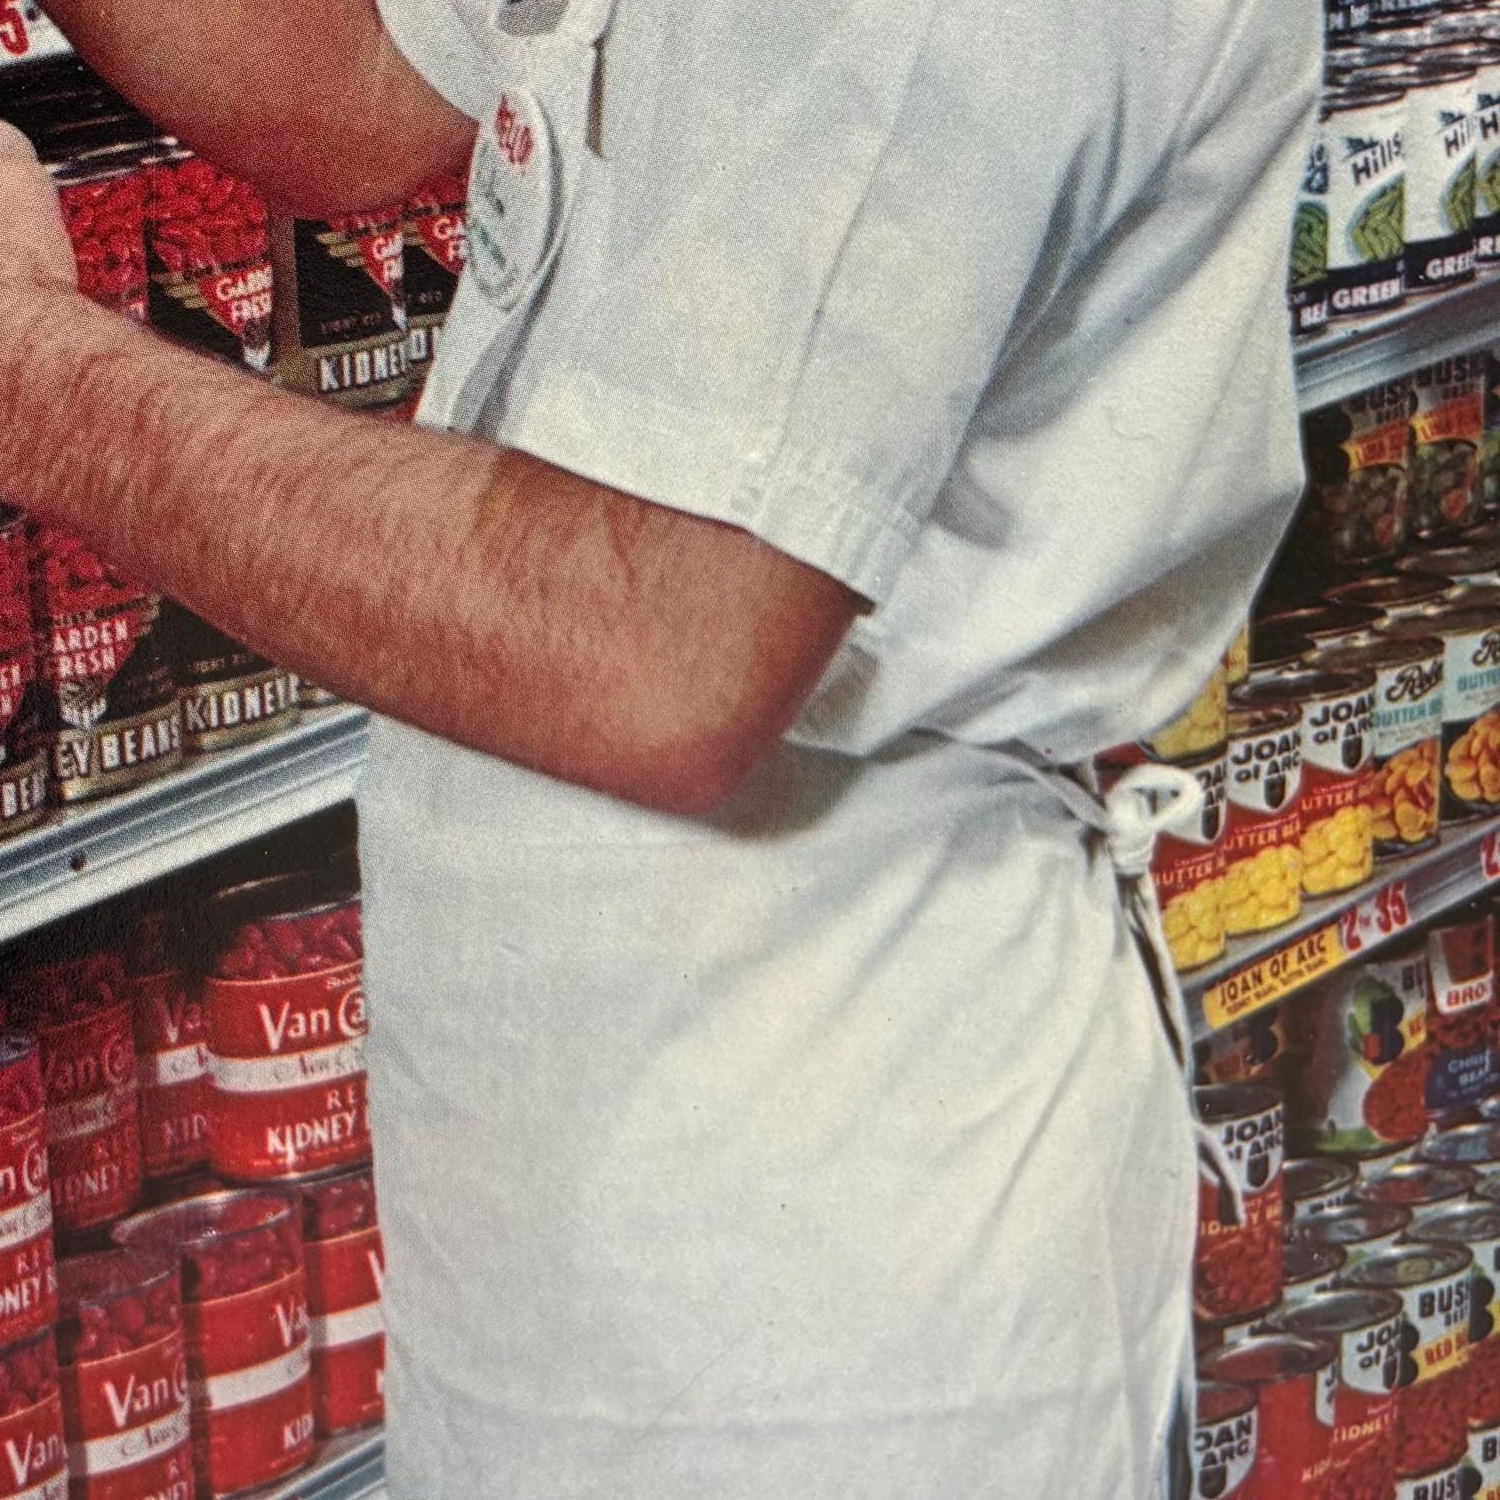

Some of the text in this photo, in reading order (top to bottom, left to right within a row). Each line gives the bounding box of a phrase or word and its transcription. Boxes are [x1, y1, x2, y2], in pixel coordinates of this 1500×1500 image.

[1352, 131, 1402, 185] Hills
[100, 713, 182, 770] BEANS
[1313, 726, 1338, 745] of
[1234, 763, 1260, 784] of
[1342, 908, 1362, 952] 2
[1220, 968, 1264, 1008] JOAN
[1270, 951, 1289, 978] OF
[1297, 933, 1326, 964] ARC
[258, 999, 330, 1053] Van
[266, 1111, 358, 1166] KIDNEY
[104, 1375, 170, 1429] Van
